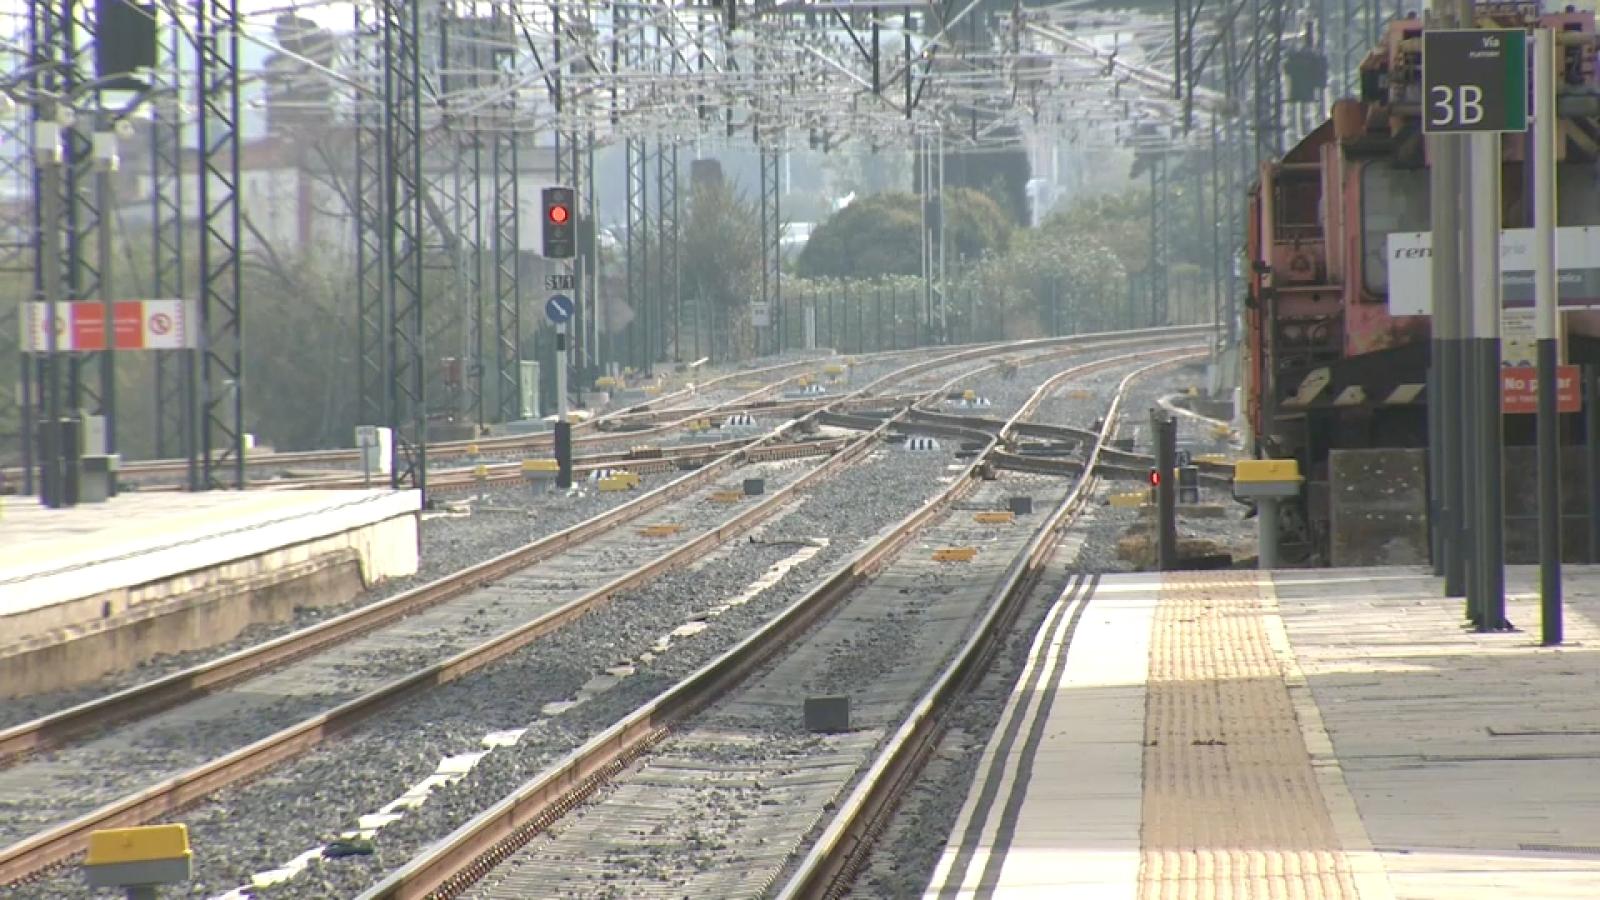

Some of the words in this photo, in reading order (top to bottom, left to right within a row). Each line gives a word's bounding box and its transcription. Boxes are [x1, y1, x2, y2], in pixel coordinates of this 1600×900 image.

[1431, 85, 1484, 126] 3B
[1395, 247, 1432, 259] ren
[1505, 378, 1525, 390] No
[1528, 378, 1572, 392] par
